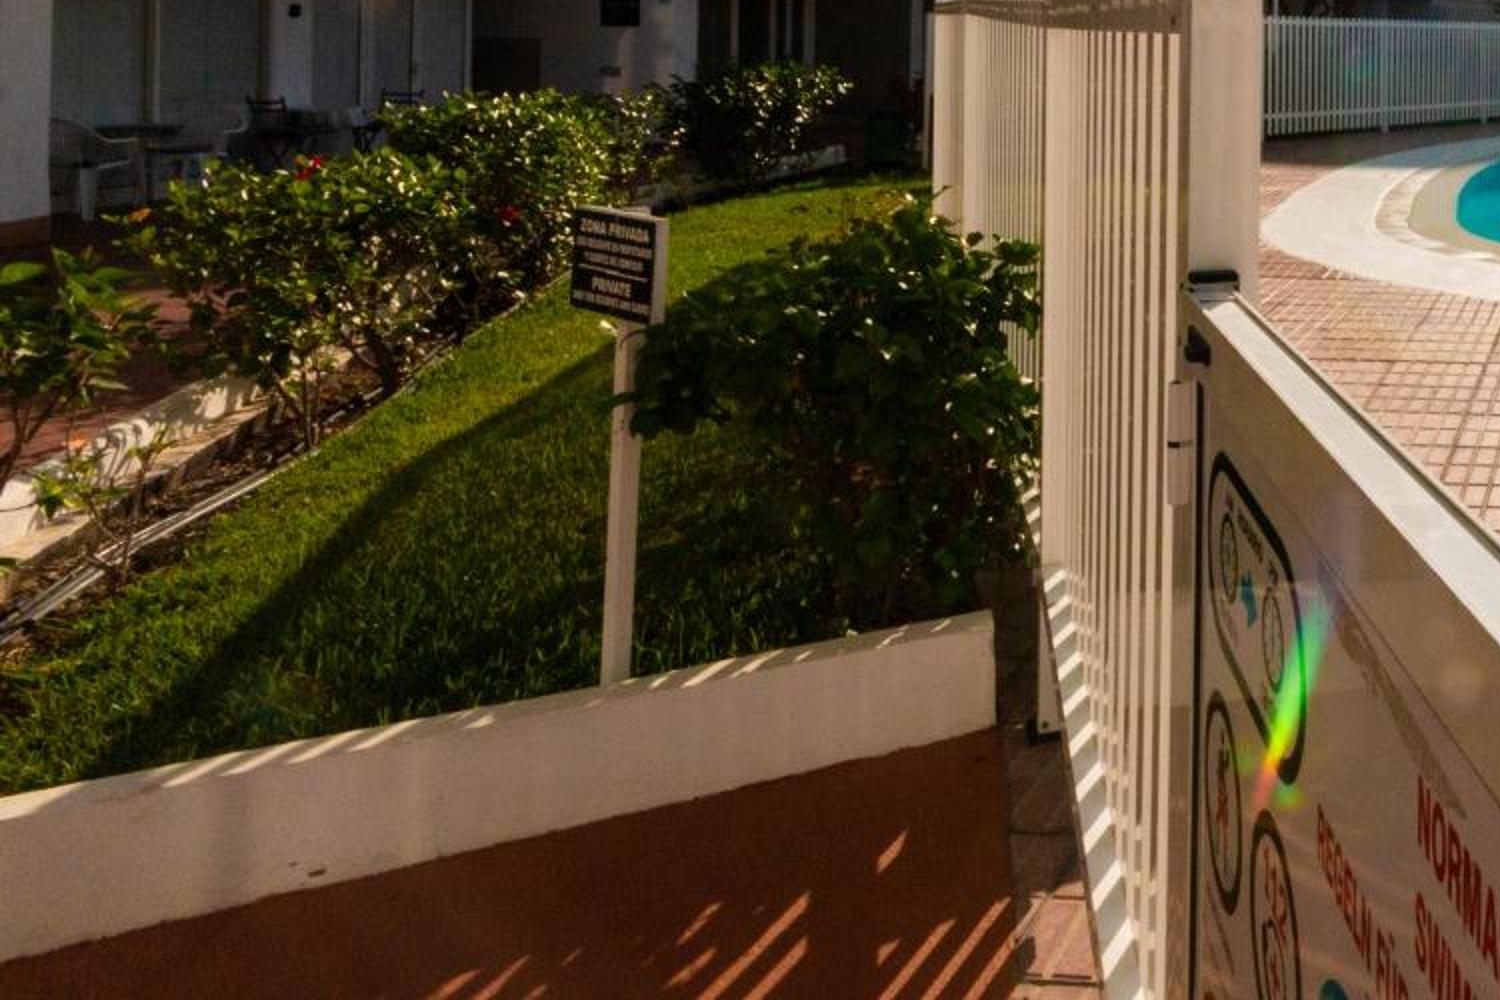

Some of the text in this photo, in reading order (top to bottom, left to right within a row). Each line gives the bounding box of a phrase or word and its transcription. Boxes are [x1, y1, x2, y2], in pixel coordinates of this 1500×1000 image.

[580, 216, 649, 243] ZONA PRIVADA
[591, 277, 632, 299] PRIVATE
[1317, 803, 1372, 974] REGELN
